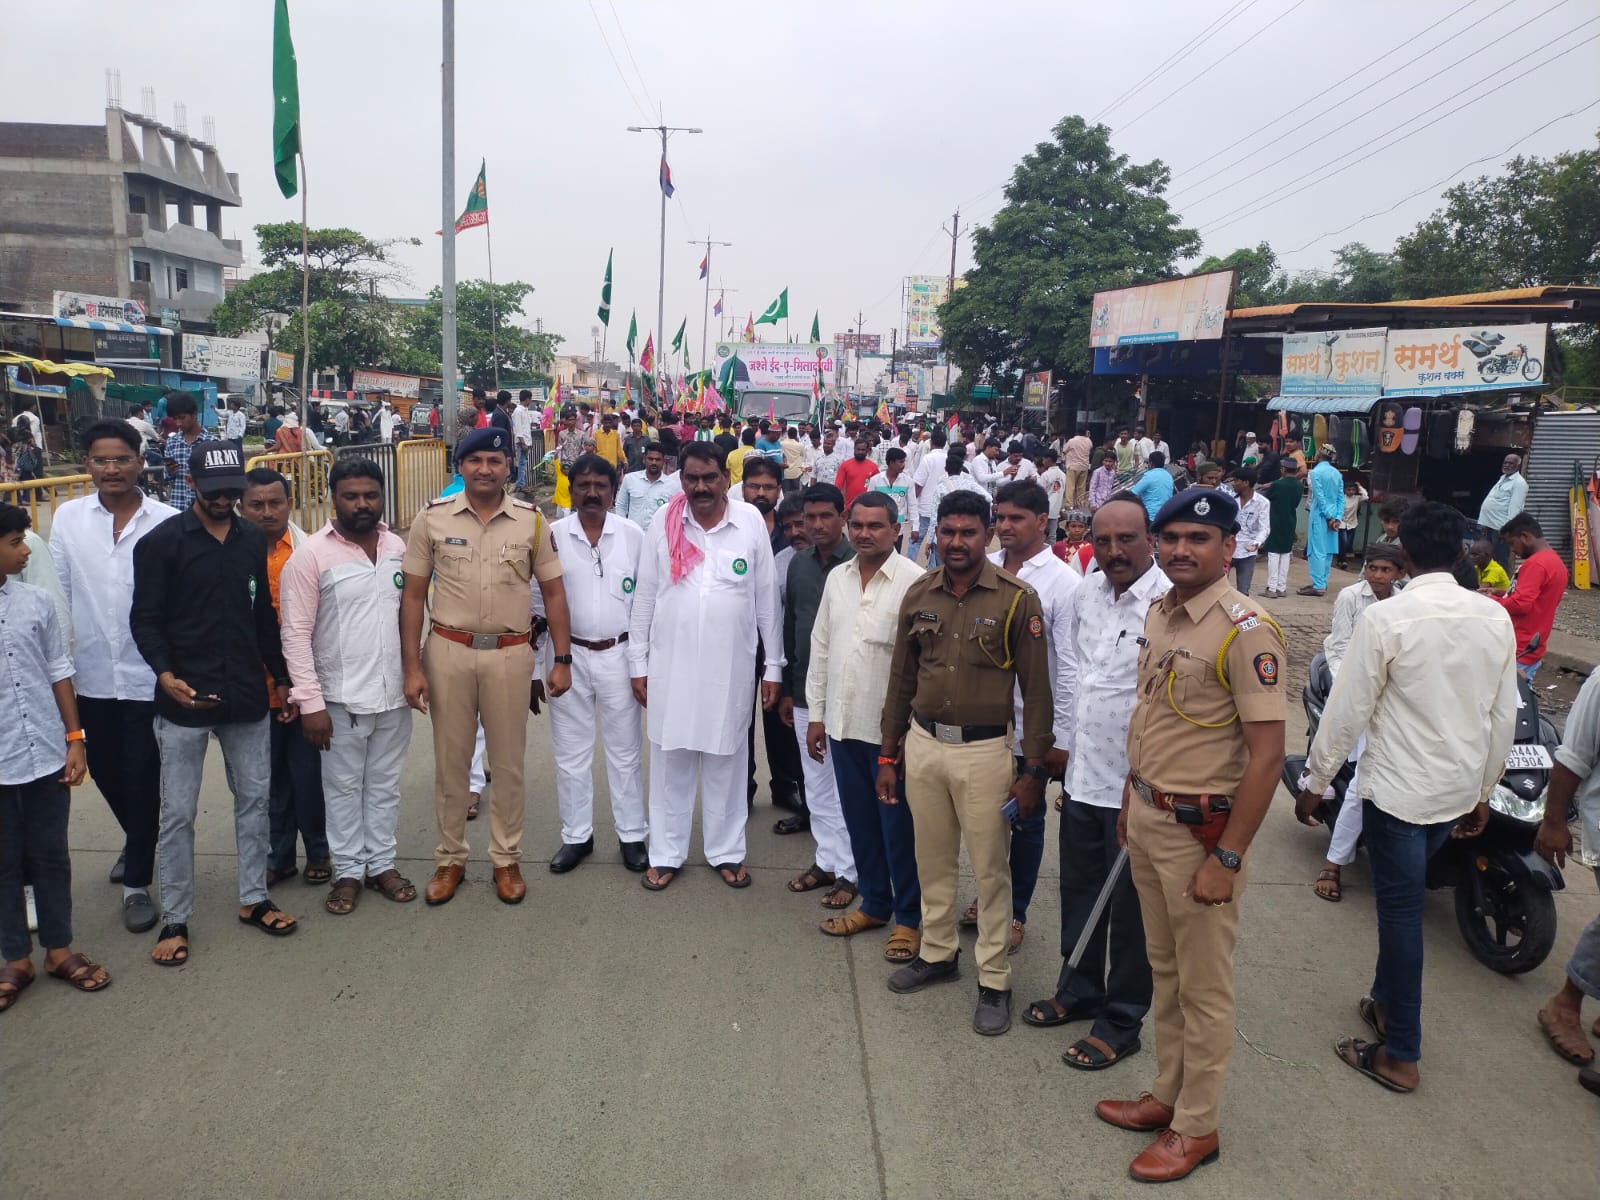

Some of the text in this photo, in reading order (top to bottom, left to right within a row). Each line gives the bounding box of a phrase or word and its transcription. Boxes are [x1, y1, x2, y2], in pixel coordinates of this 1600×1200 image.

[1394, 333, 1462, 372] समर्थ
[749, 357, 768, 371] जश्ने
[1286, 344, 1380, 382] समर्थ कुशन
[1418, 371, 1441, 385] कुशन
[204, 449, 240, 466] ARMY
[1511, 746, 1539, 756] H44A
